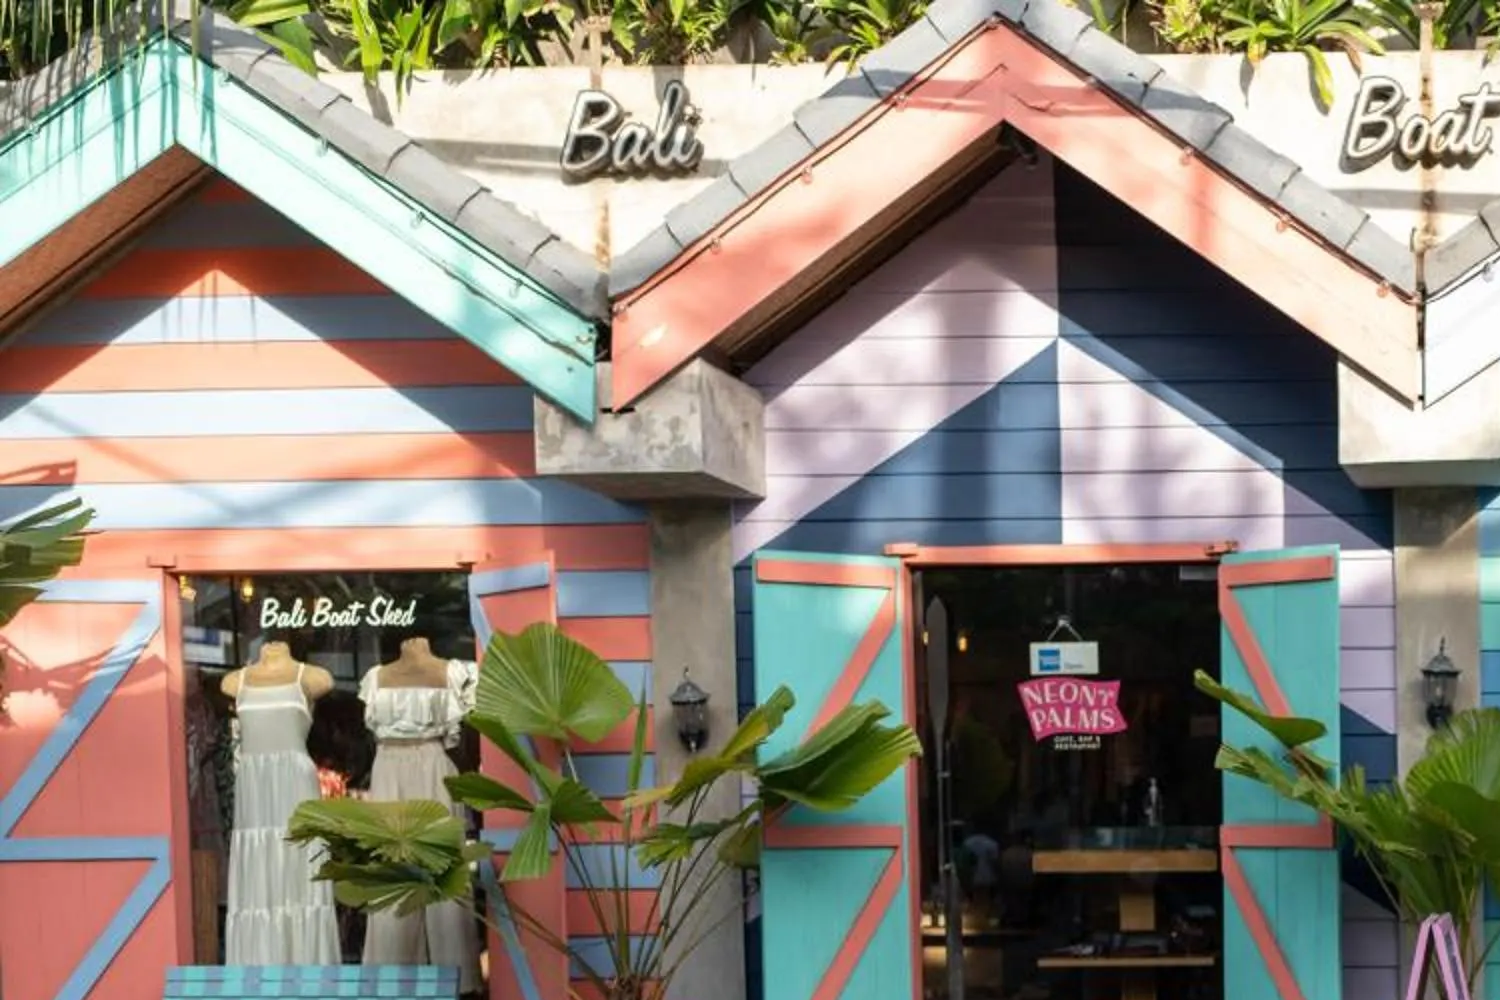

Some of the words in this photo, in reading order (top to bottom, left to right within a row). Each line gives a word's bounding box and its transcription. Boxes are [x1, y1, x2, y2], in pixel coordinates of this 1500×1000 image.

[561, 80, 704, 170] Bali
[260, 597, 307, 628] Bali
[311, 597, 365, 626] Boat
[365, 595, 417, 626] Shed
[1023, 682, 1096, 708] NEON
[1031, 707, 1115, 732] PALMS
